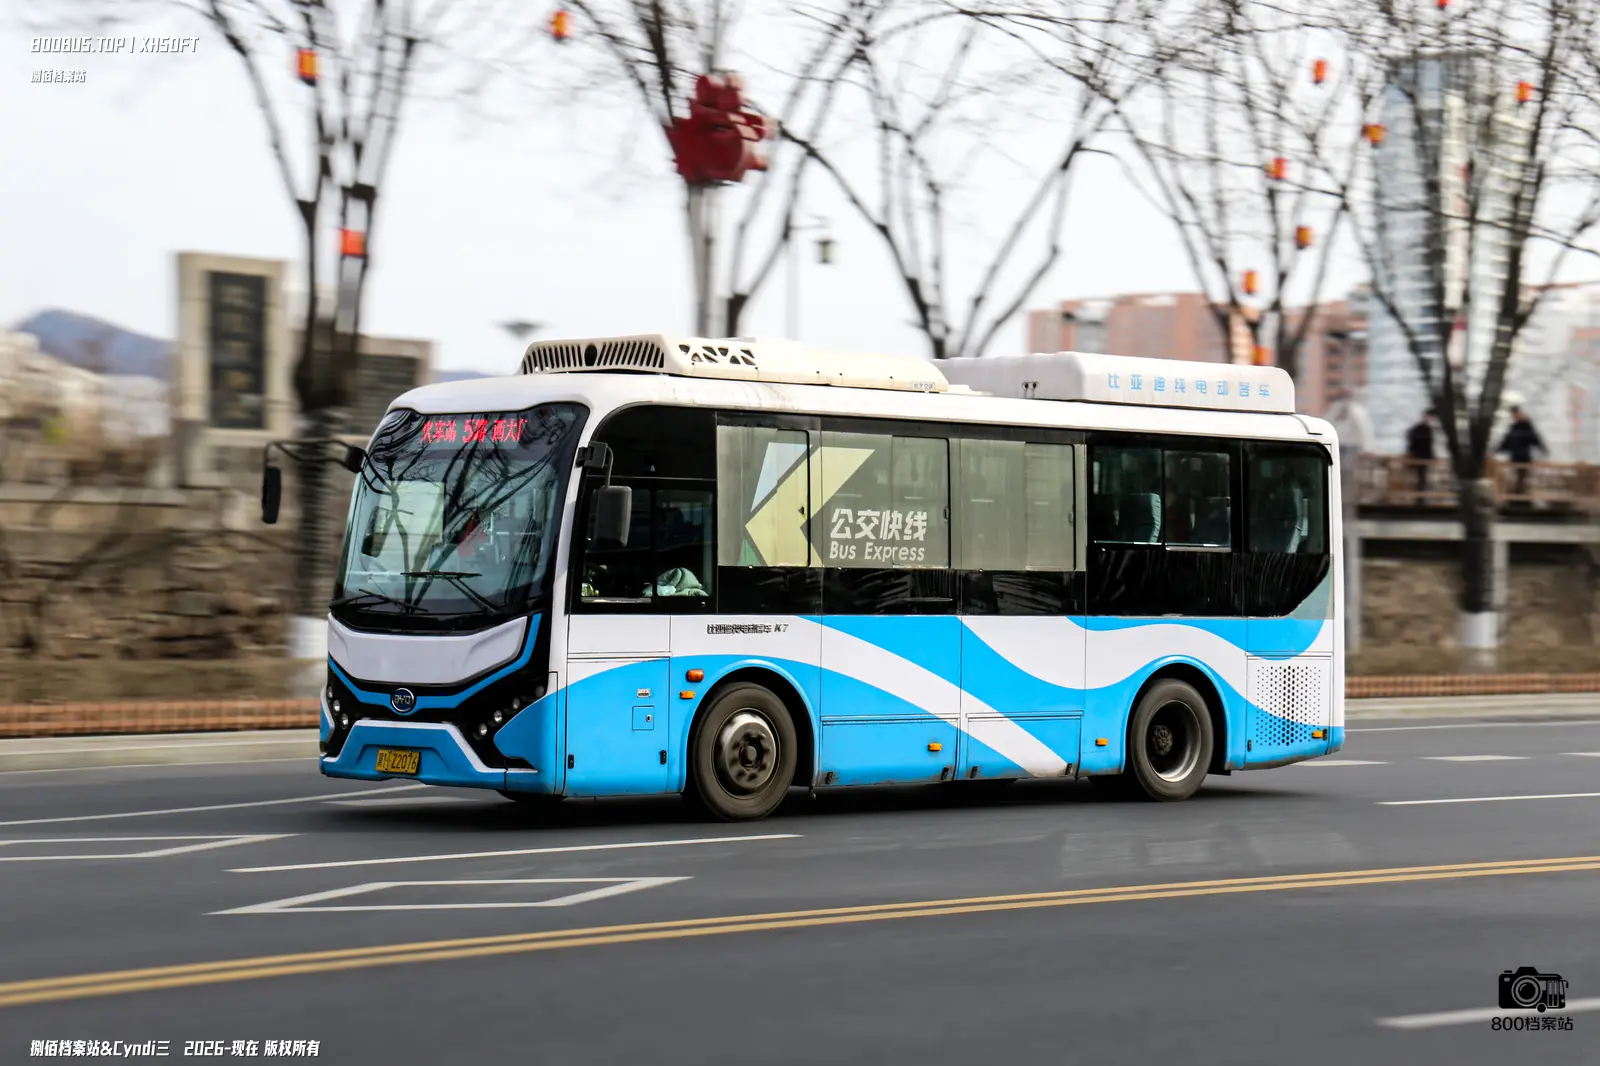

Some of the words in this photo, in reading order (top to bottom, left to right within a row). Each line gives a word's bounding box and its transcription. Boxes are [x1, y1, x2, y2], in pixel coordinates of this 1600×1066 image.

[1107, 372, 1271, 398] 比亚迪纯电动客车
[420, 419, 457, 444] 火车站
[830, 508, 928, 541] 公交快线
[829, 541, 857, 560] Bus
[864, 542, 925, 562] Express
[394, 694, 411, 705] BYD
